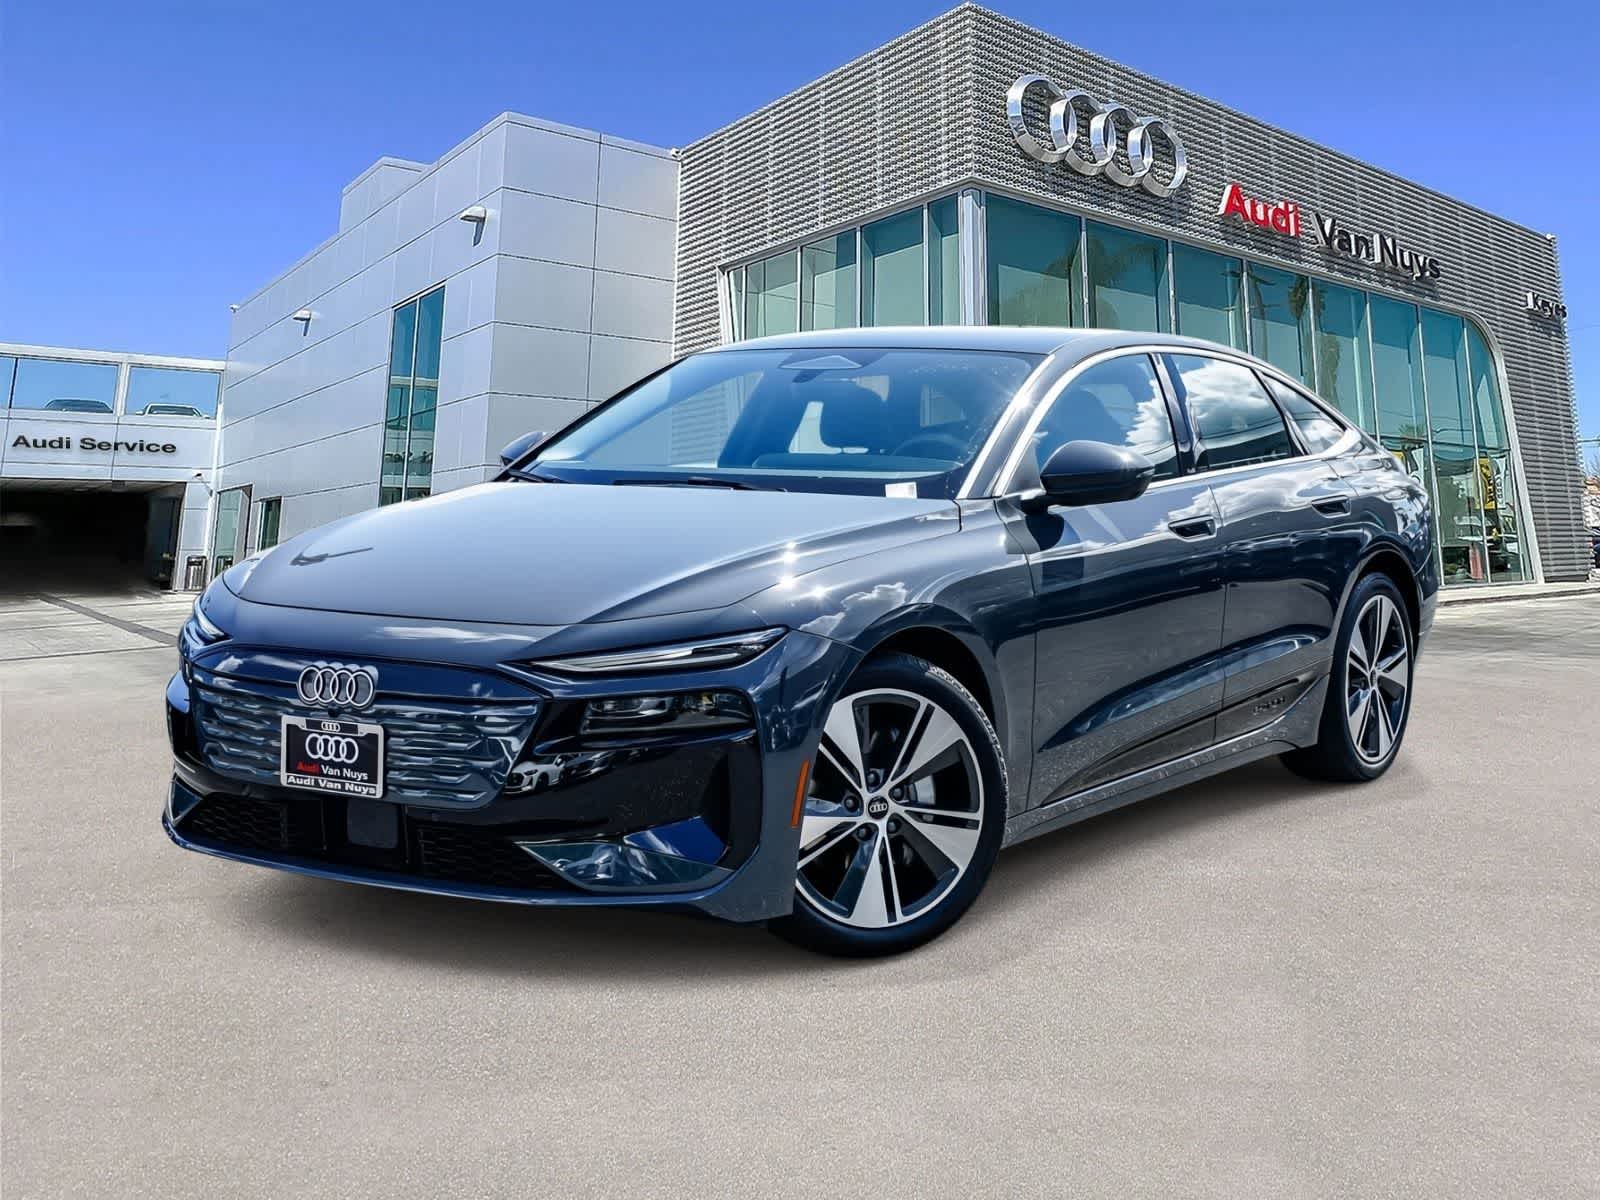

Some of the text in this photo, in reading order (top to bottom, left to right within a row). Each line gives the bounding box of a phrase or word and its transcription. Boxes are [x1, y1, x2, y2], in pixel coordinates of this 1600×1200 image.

[1219, 183, 1441, 281] Audi Van Nuys
[12, 435, 177, 453] Audi Service
[321, 764, 341, 776] Van
[343, 768, 368, 780] Nuys
[287, 775, 377, 794] Audi Van Nuys
